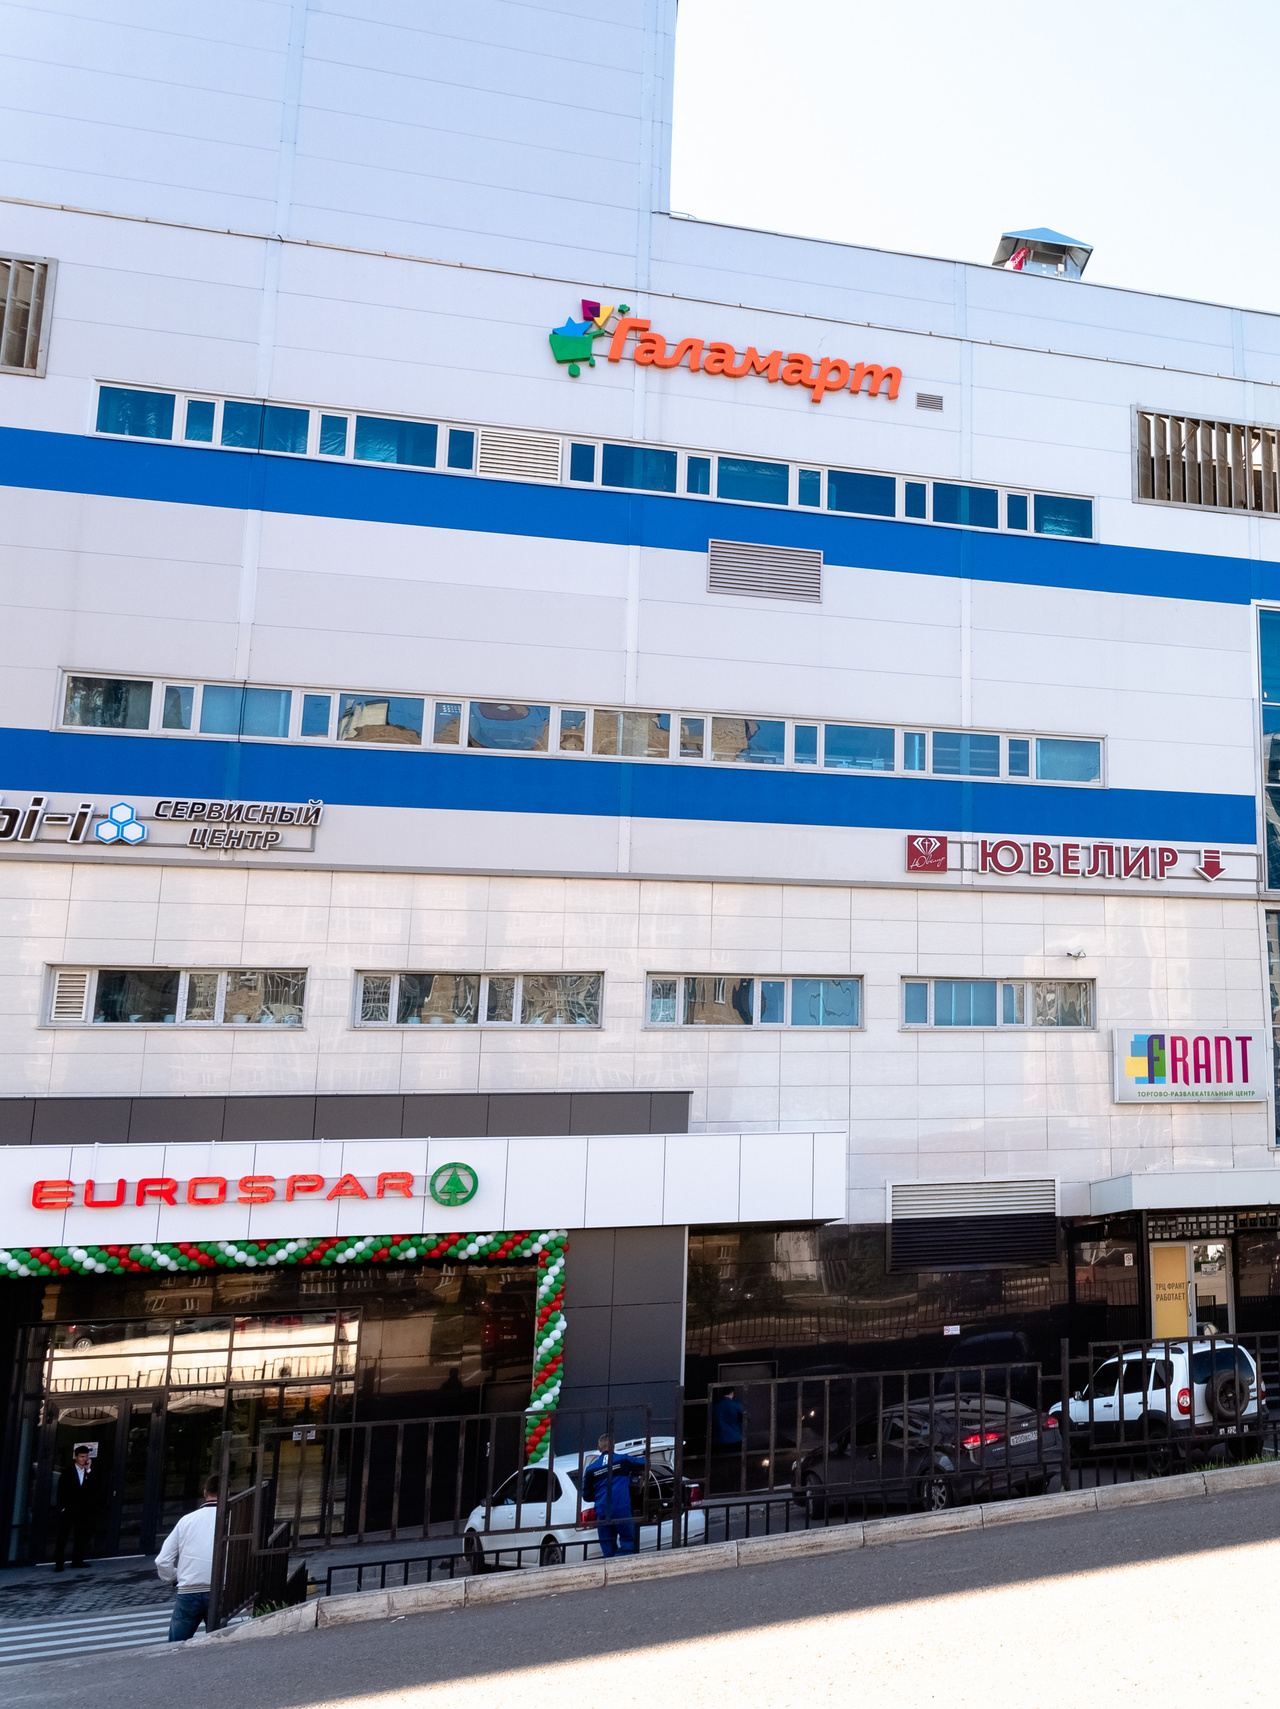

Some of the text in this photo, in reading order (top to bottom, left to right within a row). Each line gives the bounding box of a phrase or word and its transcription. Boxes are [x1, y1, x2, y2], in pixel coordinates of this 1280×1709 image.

[608, 317, 903, 403] Галамарт
[154, 799, 324, 827] СЕРВИСНЫЙ
[187, 826, 283, 850] ЦЕНТР
[977, 838, 1180, 881] ЮВЕЛИР
[1146, 1033, 1253, 1087] FRANT
[1137, 1089, 1256, 1098] ТОРГОВО-РАЗВЛЕКАТЕЛЬНЫЙ ЦЕНТР
[32, 1171, 415, 1210] EUROSPAR
[1155, 1282, 1185, 1291] ТРЦ ФРАНТ
[1155, 1292, 1186, 1302] РАБОТАЕТ
